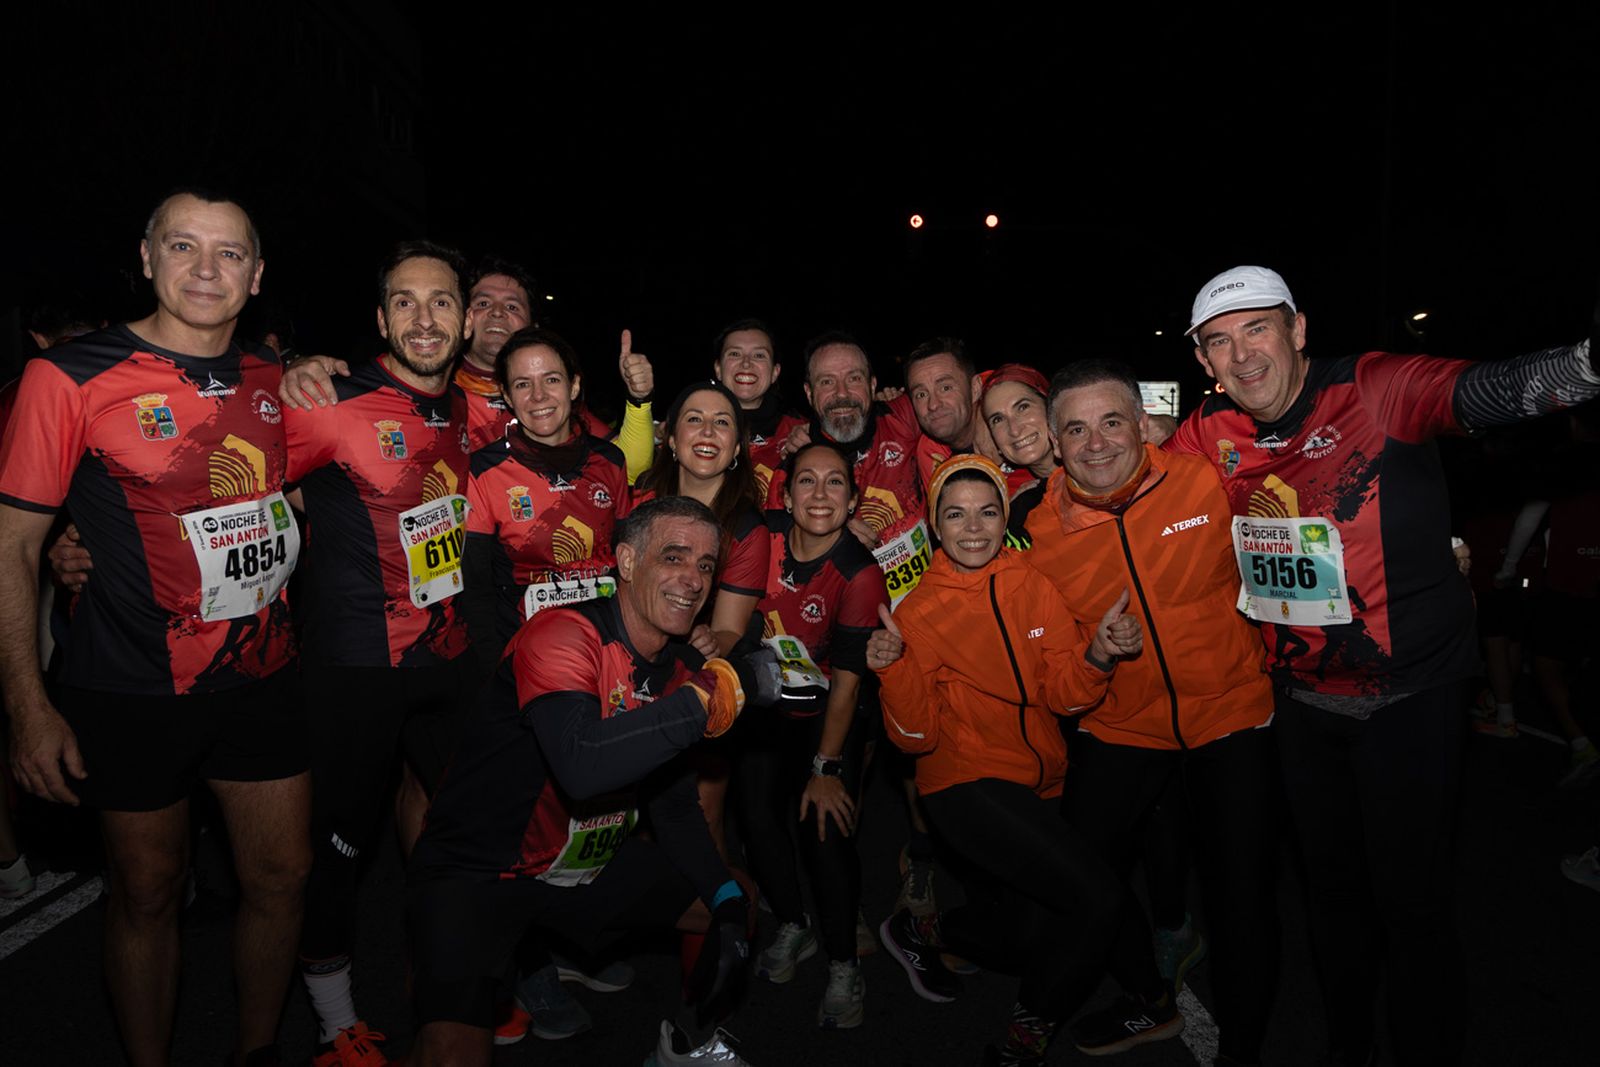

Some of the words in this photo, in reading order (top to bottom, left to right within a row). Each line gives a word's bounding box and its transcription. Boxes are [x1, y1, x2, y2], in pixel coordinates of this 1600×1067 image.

[220, 514, 257, 531] NOCHE
[416, 511, 440, 528] NOCHE
[1172, 514, 1210, 533] TERREX
[210, 532, 235, 550] SAN
[410, 528, 429, 545] SAN
[1251, 529, 1278, 540] NOCHE
[1280, 530, 1291, 540] DE
[1243, 540, 1260, 552] SAN
[225, 534, 287, 581] 4854
[879, 550, 898, 564] OCHE
[884, 547, 930, 591] 3391
[1252, 555, 1318, 589] 5156
[549, 591, 578, 601] NOCHE
[580, 589, 590, 598] DE
[1269, 590, 1297, 599] MARCIAL
